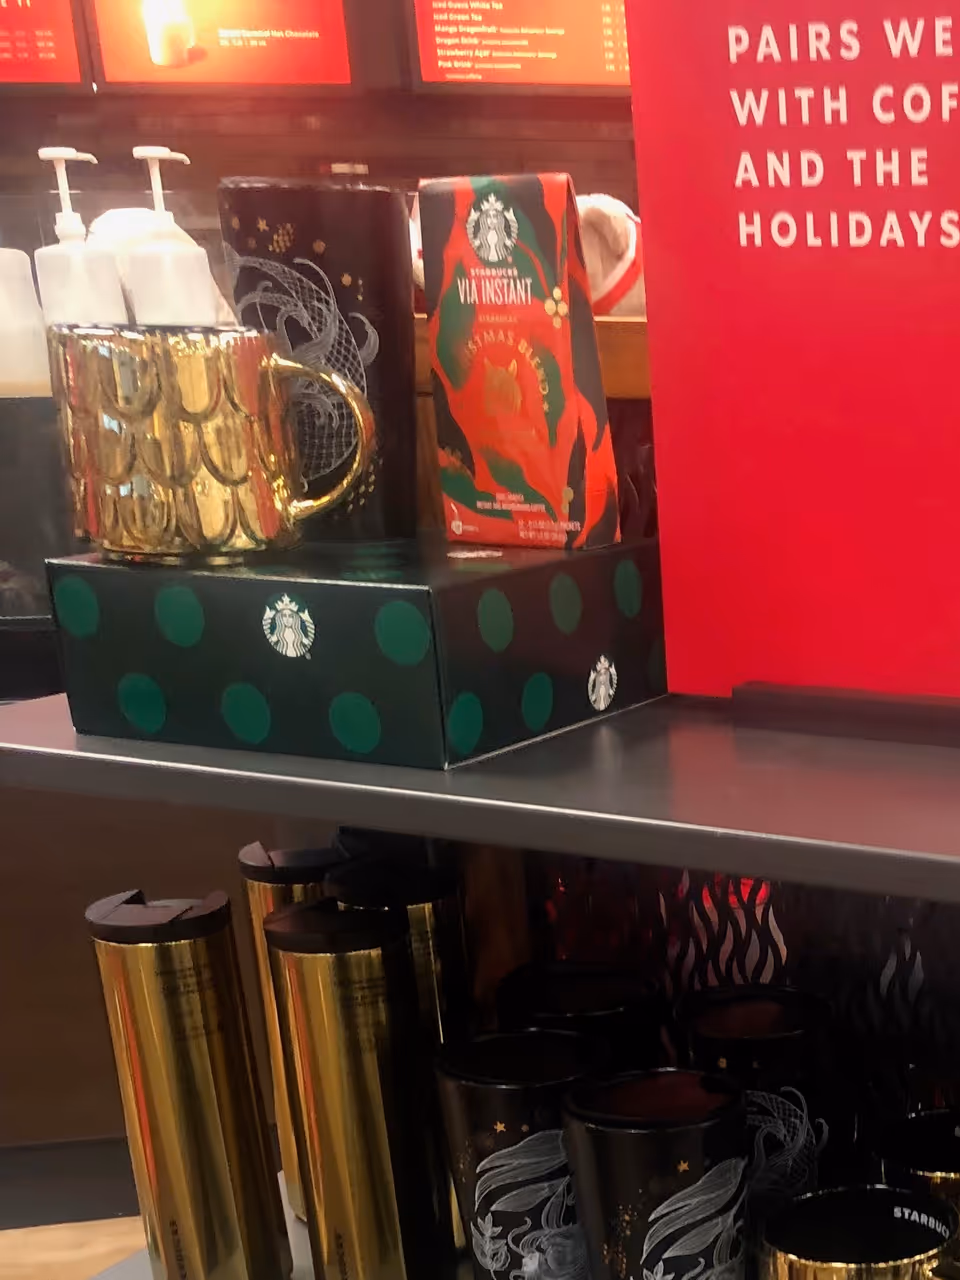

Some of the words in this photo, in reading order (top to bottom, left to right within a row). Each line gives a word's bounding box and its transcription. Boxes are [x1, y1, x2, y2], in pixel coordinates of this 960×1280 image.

[728, 19, 860, 64] PAIRS
[729, 84, 848, 126] WITH
[735, 148, 824, 187] AND
[847, 147, 928, 186] THE
[738, 210, 960, 248] HOLIDAYS
[457, 277, 479, 305] VIA
[481, 277, 533, 305] INSTANT
[470, 267, 518, 277] STARBUCKS
[893, 1205, 950, 1240] STARBUC
